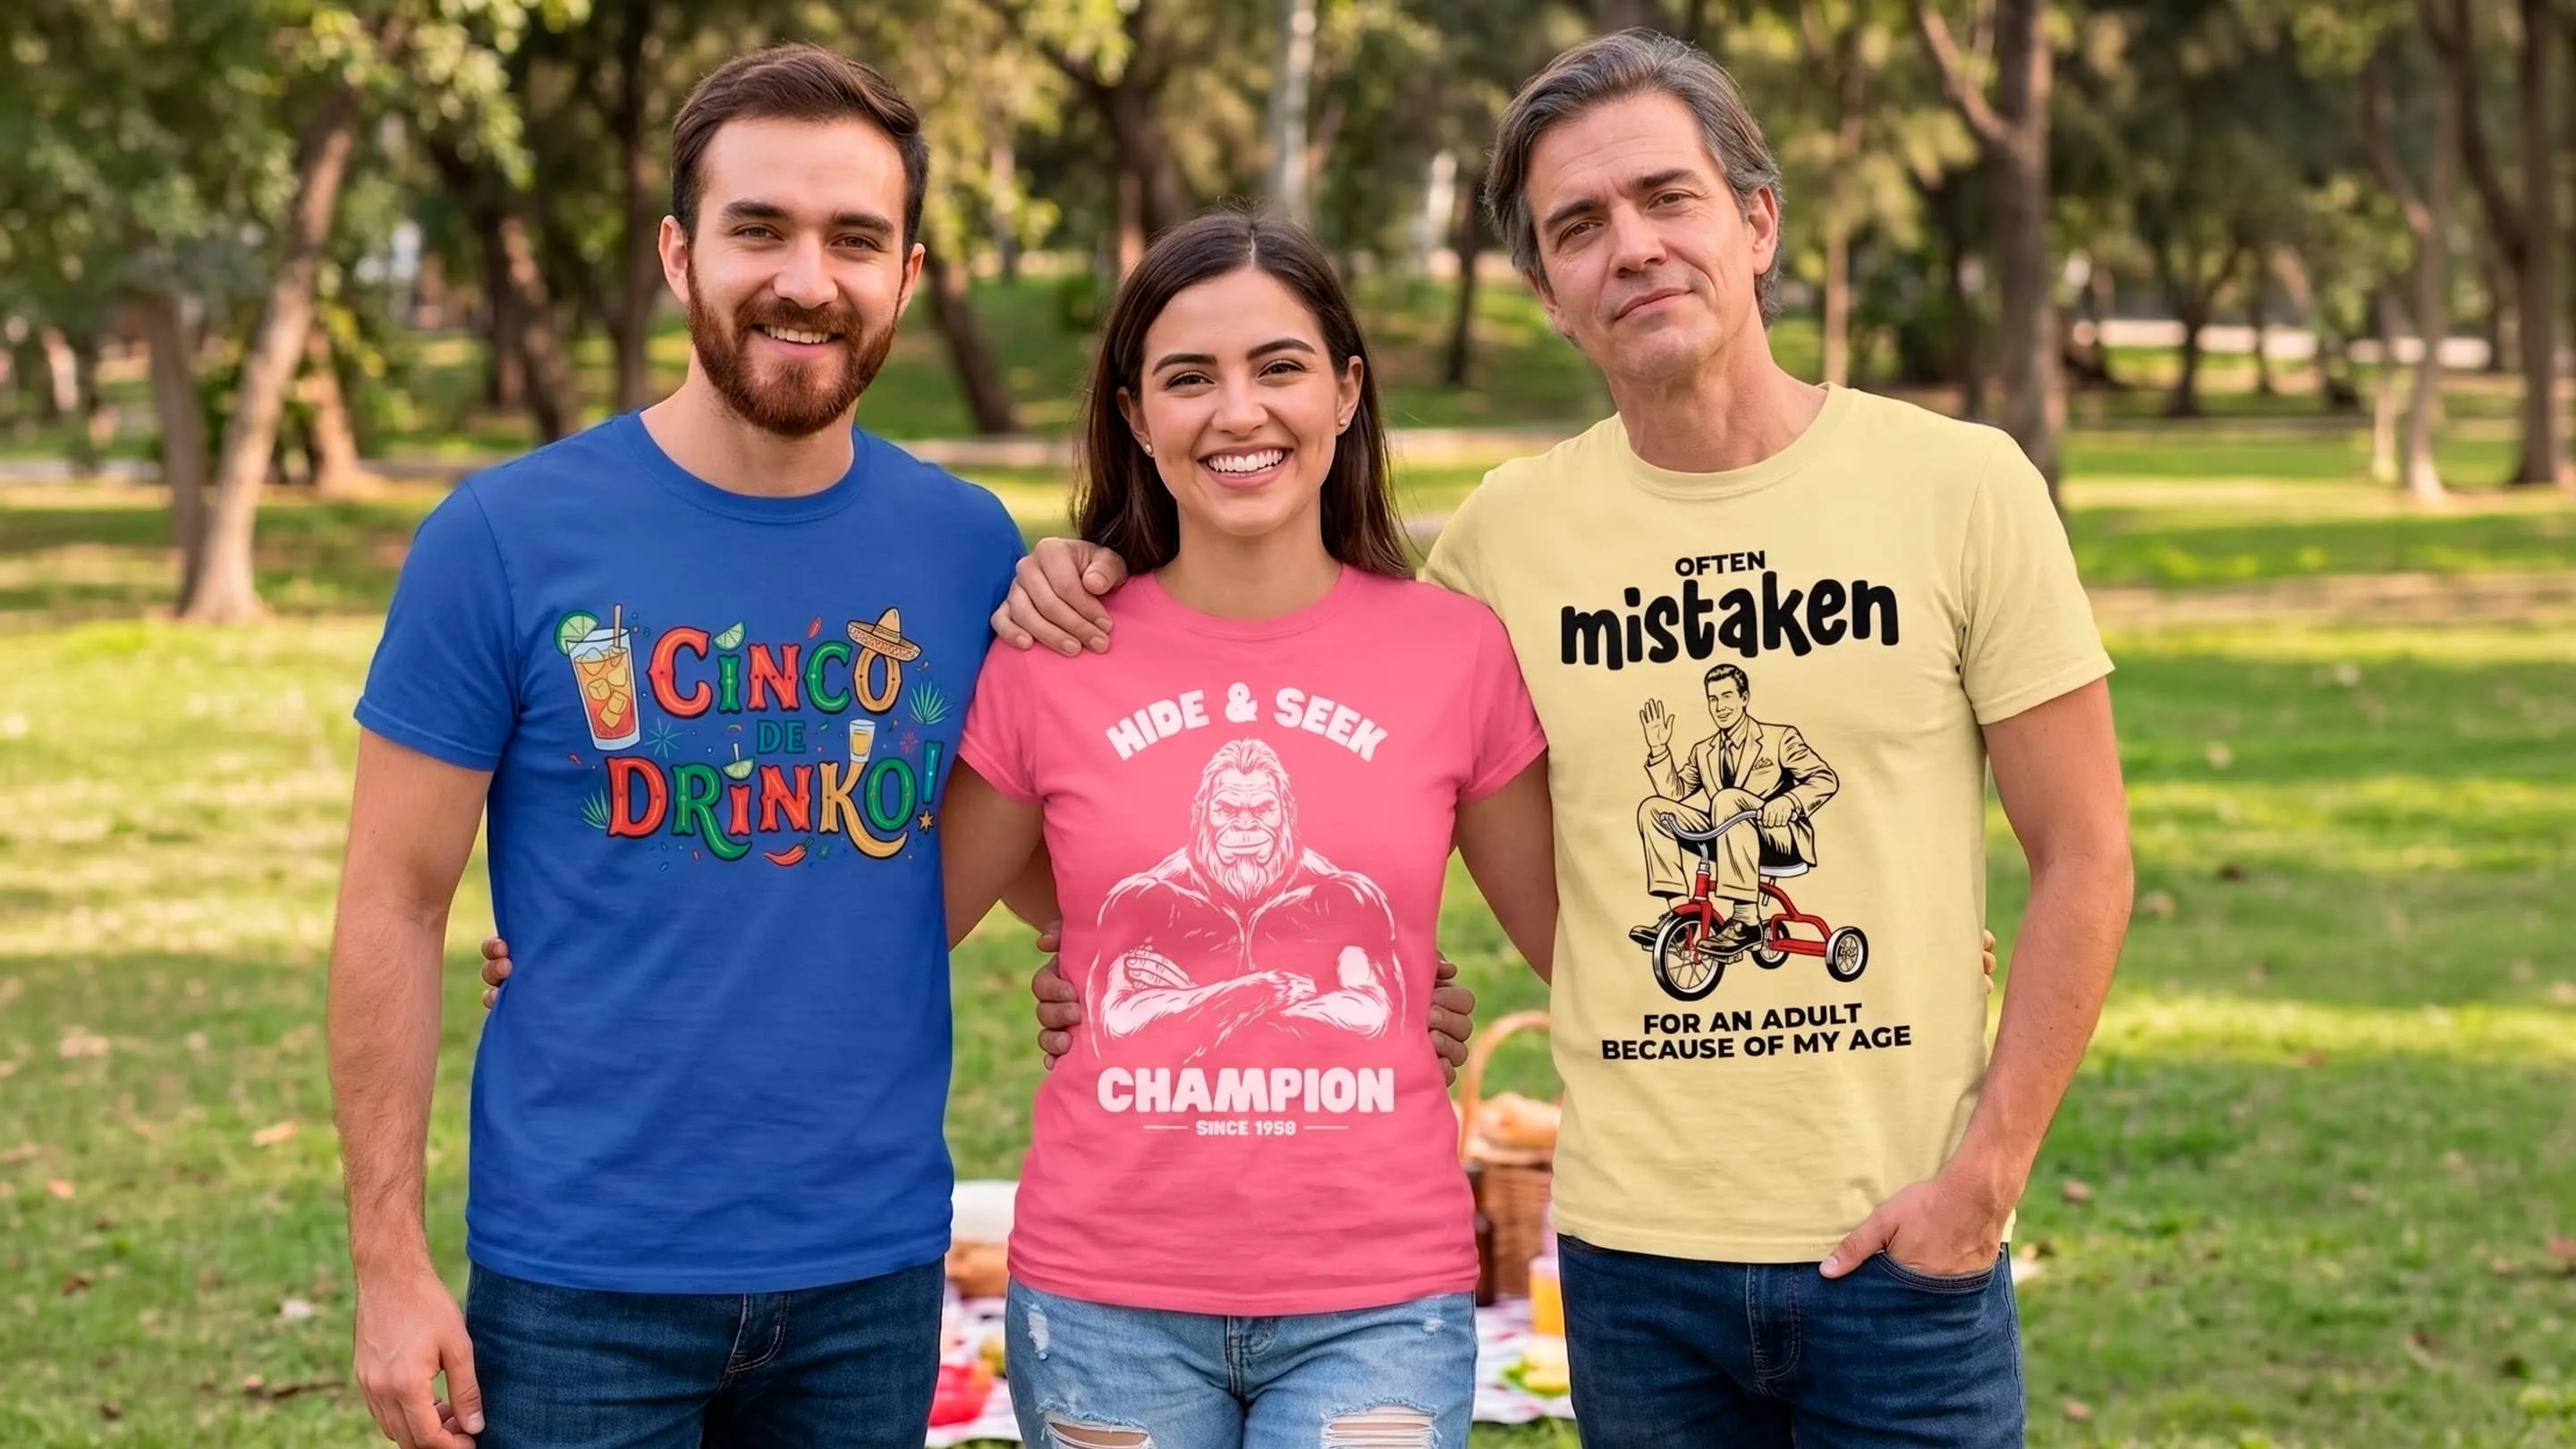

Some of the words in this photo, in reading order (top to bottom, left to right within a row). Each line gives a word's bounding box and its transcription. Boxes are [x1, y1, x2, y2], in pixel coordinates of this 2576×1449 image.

[1674, 550, 1766, 577] OFTEN
[1561, 571, 1899, 671] mistaken
[647, 627, 902, 716] CINCO
[757, 719, 807, 754] DE
[1106, 690, 1210, 760] HIDE
[1224, 682, 1258, 723] &
[1274, 688, 1388, 762] SEEK
[606, 741, 945, 860] DRINKO!
[1643, 1013, 1700, 1035] FOR
[1709, 1010, 1754, 1032] AN
[1761, 1003, 1862, 1030] ADULT
[1601, 1038, 1734, 1060] BECAUSE
[1743, 1035, 1784, 1057] OF
[1793, 1032, 1840, 1054] MY
[1850, 1025, 1911, 1050] AGE
[1097, 1067, 1394, 1113] CHAMPION
[1196, 1121, 1248, 1136] SINCE
[1255, 1120, 1296, 1136] 1958
